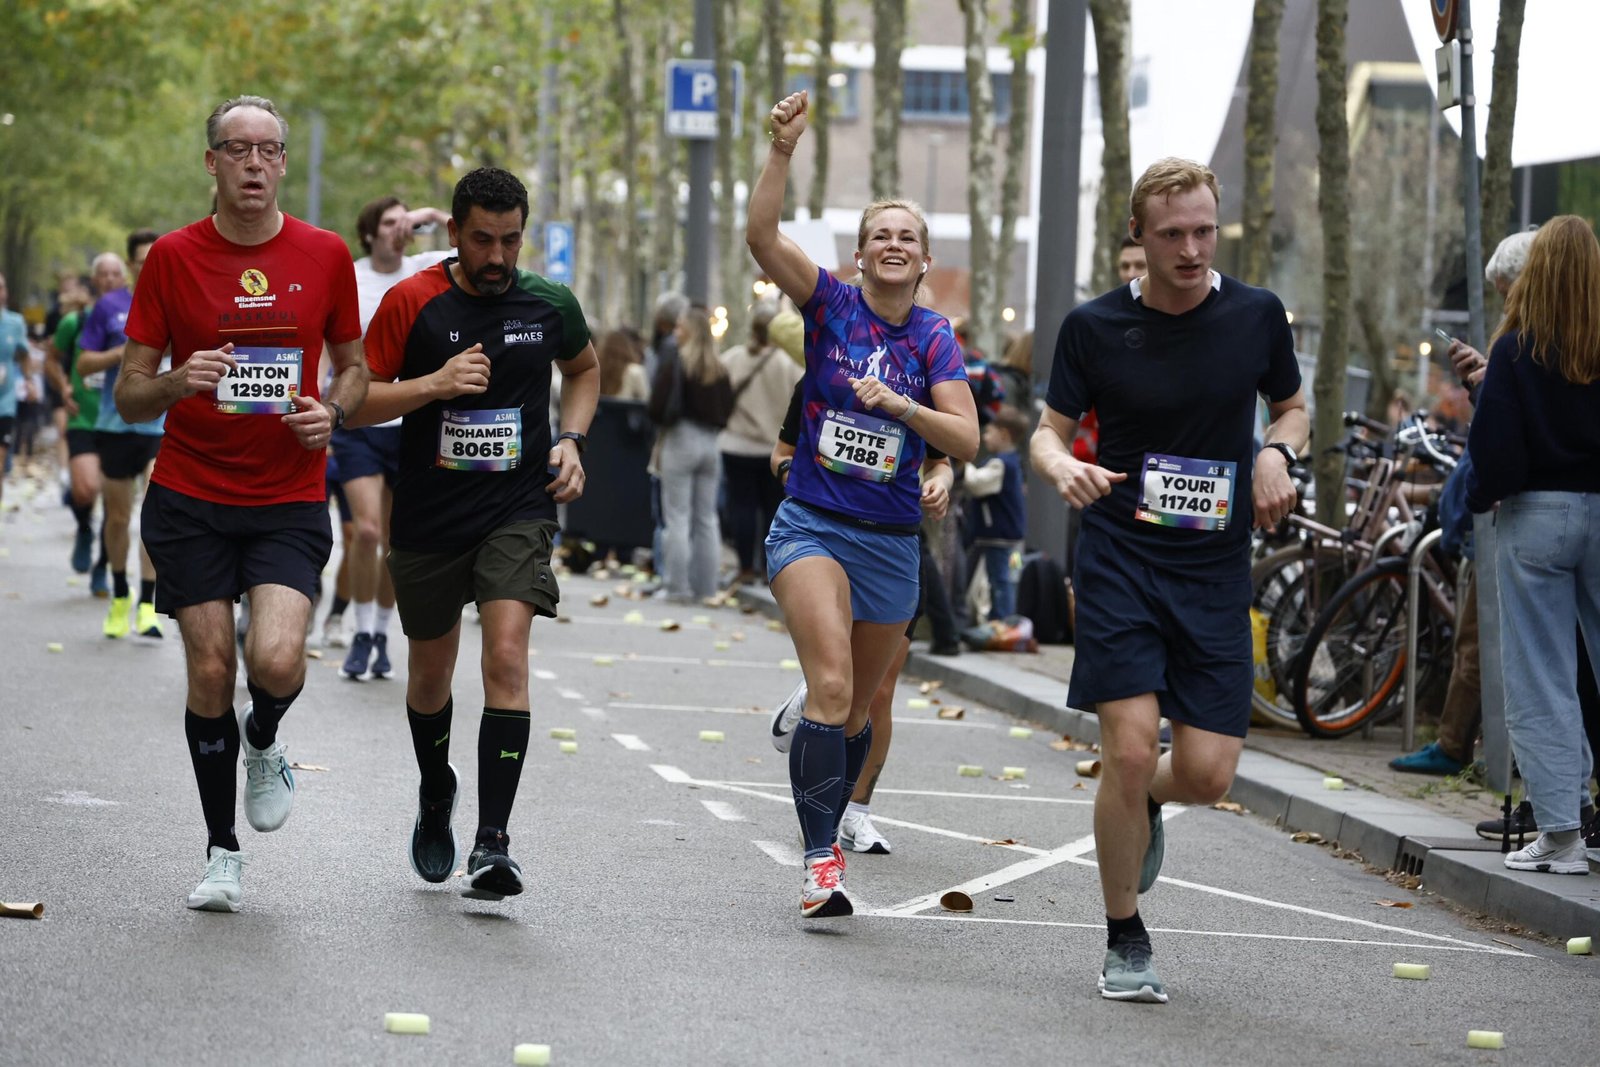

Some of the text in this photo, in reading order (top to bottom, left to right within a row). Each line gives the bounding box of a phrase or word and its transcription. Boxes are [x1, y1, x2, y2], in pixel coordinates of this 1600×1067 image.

[692, 73, 717, 105] P
[234, 294, 276, 303] Blixemsnel
[275, 353, 299, 362] ASML
[227, 366, 289, 379] ANTON
[827, 344, 926, 388] Next Level
[838, 368, 859, 380] REAL
[231, 383, 285, 398] 12998
[495, 413, 517, 422] ASML
[444, 426, 513, 438] MOHAMED
[834, 426, 887, 449] LOTTE
[880, 425, 902, 436] ASML
[452, 441, 504, 457] 8065
[834, 441, 879, 466] 7188
[1161, 475, 1216, 494] YOURI
[1159, 494, 1212, 513] 11740
